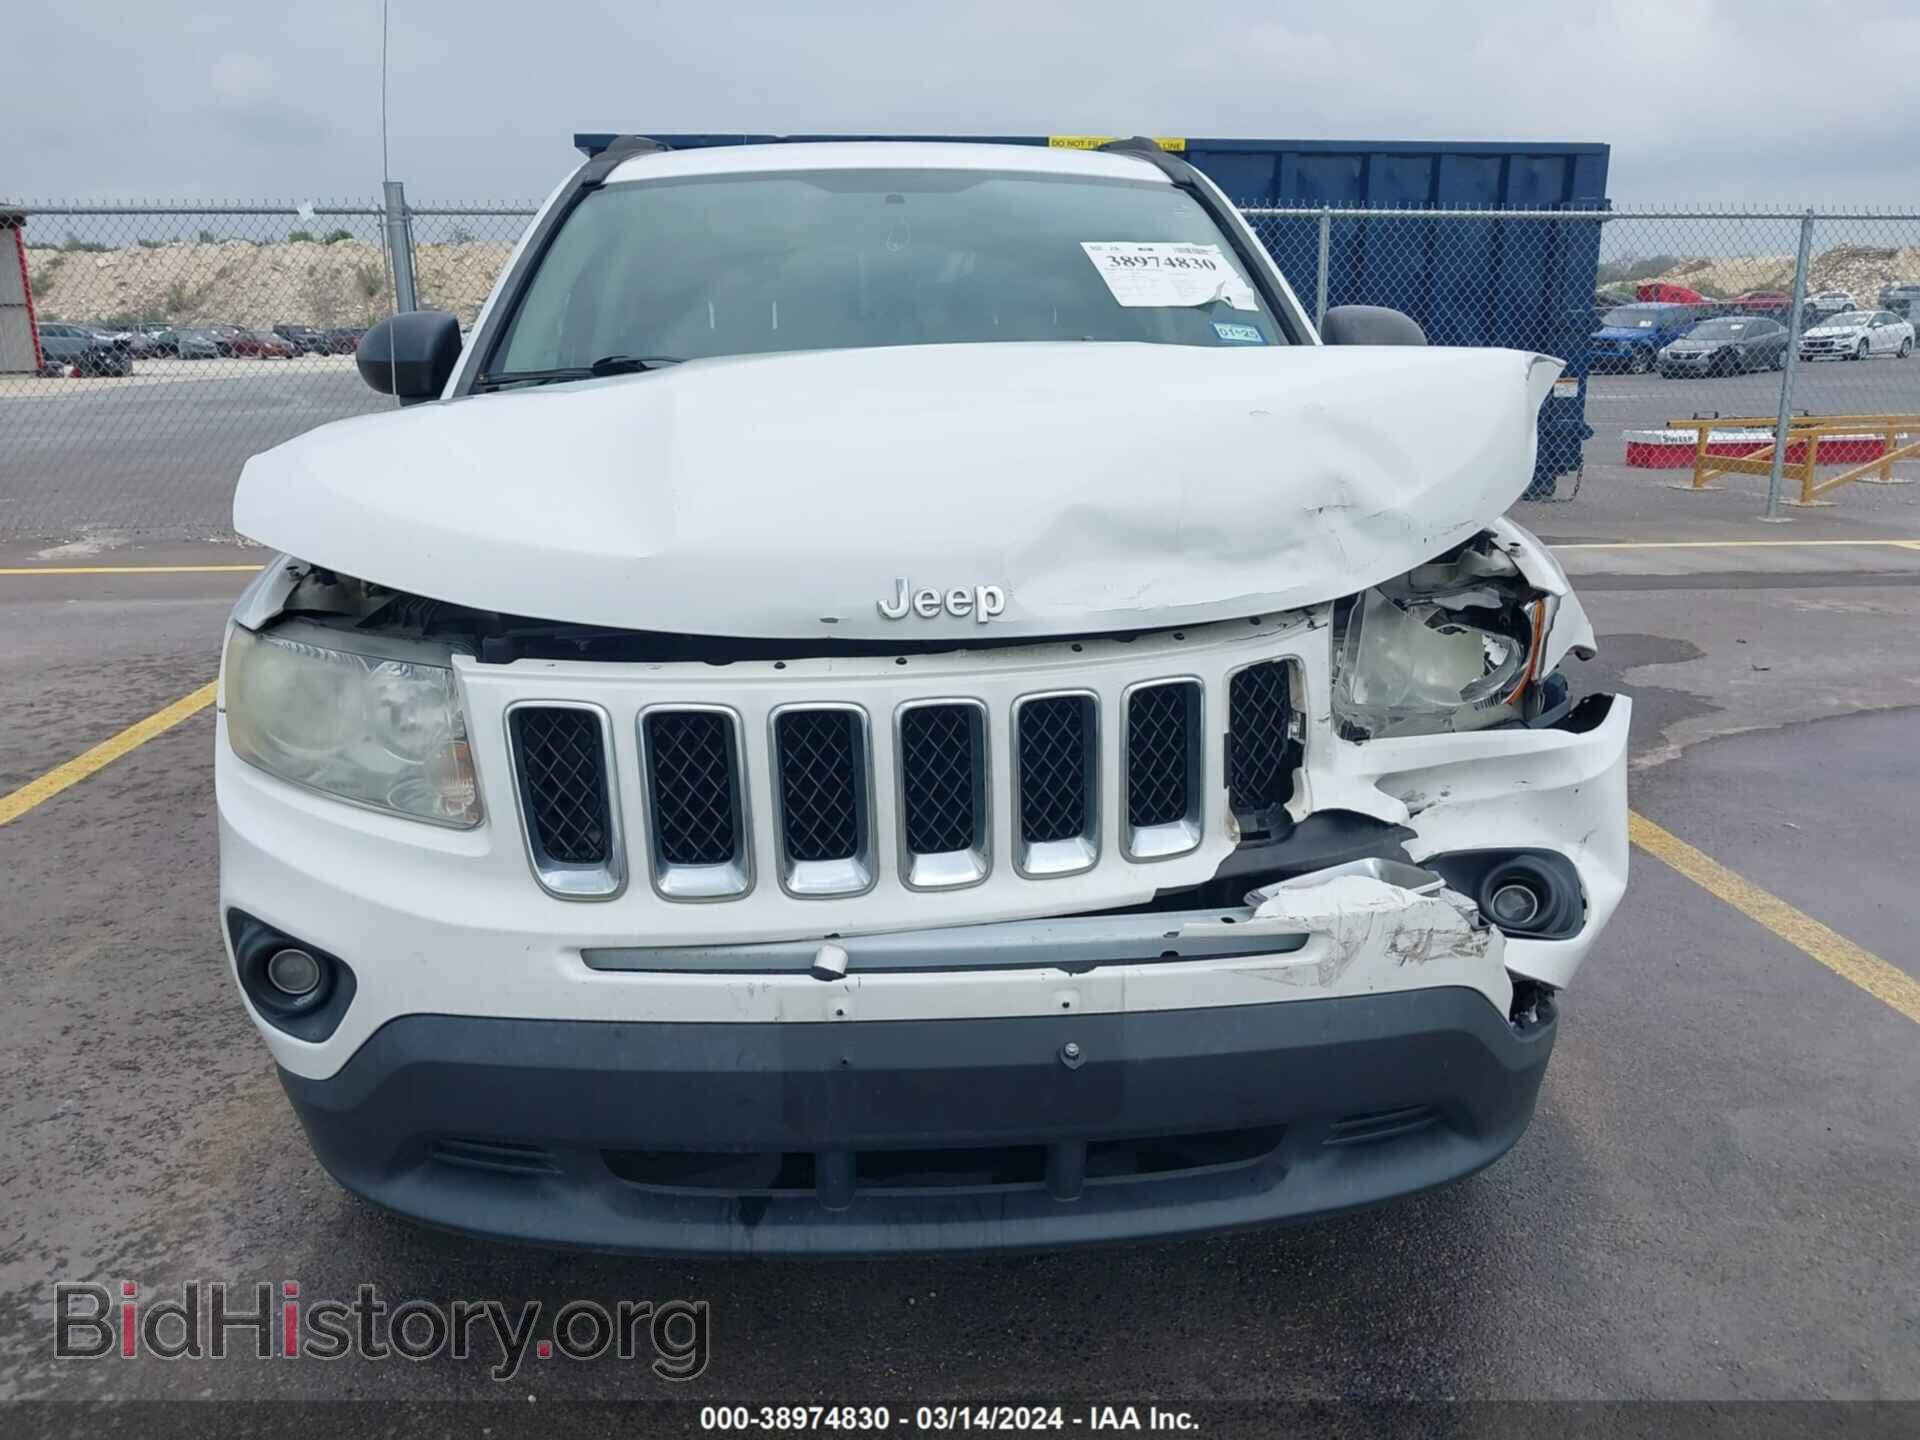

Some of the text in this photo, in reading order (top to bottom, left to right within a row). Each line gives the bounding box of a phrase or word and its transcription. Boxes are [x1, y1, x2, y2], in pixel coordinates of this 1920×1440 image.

[1052, 138, 1064, 147] DO
[1066, 138, 1084, 148] NOT
[1106, 254, 1216, 271] 38974830
[877, 576, 1006, 624] Jeep
